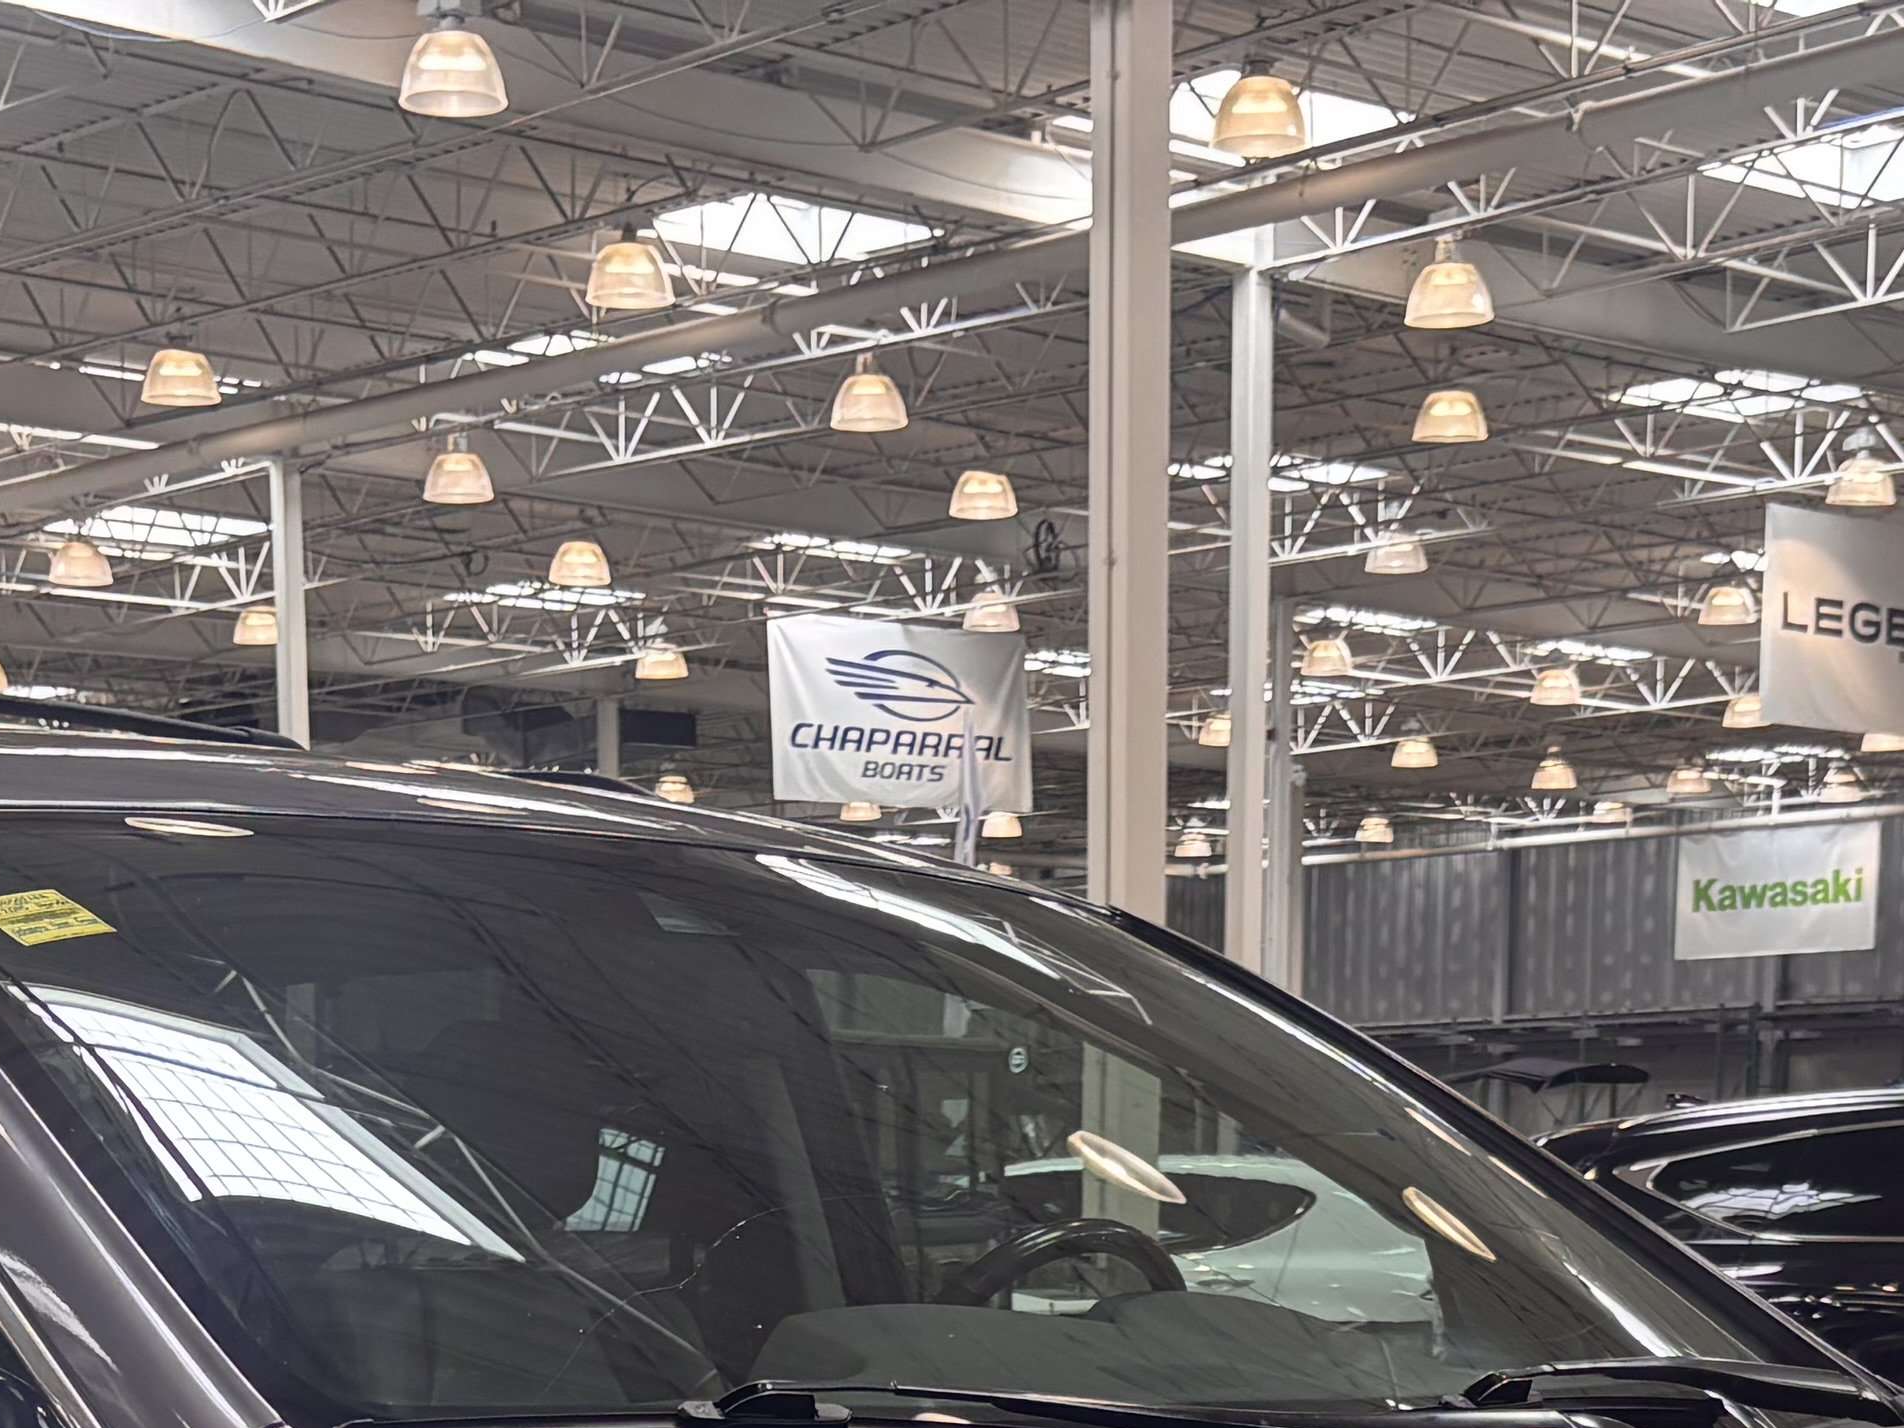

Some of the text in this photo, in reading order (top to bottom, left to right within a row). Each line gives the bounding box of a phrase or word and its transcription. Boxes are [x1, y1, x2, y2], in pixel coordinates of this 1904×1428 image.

[789, 722, 1013, 762] CHAPARRAL
[862, 761, 946, 782] BOATS
[1691, 868, 1865, 914] Kawasaki
